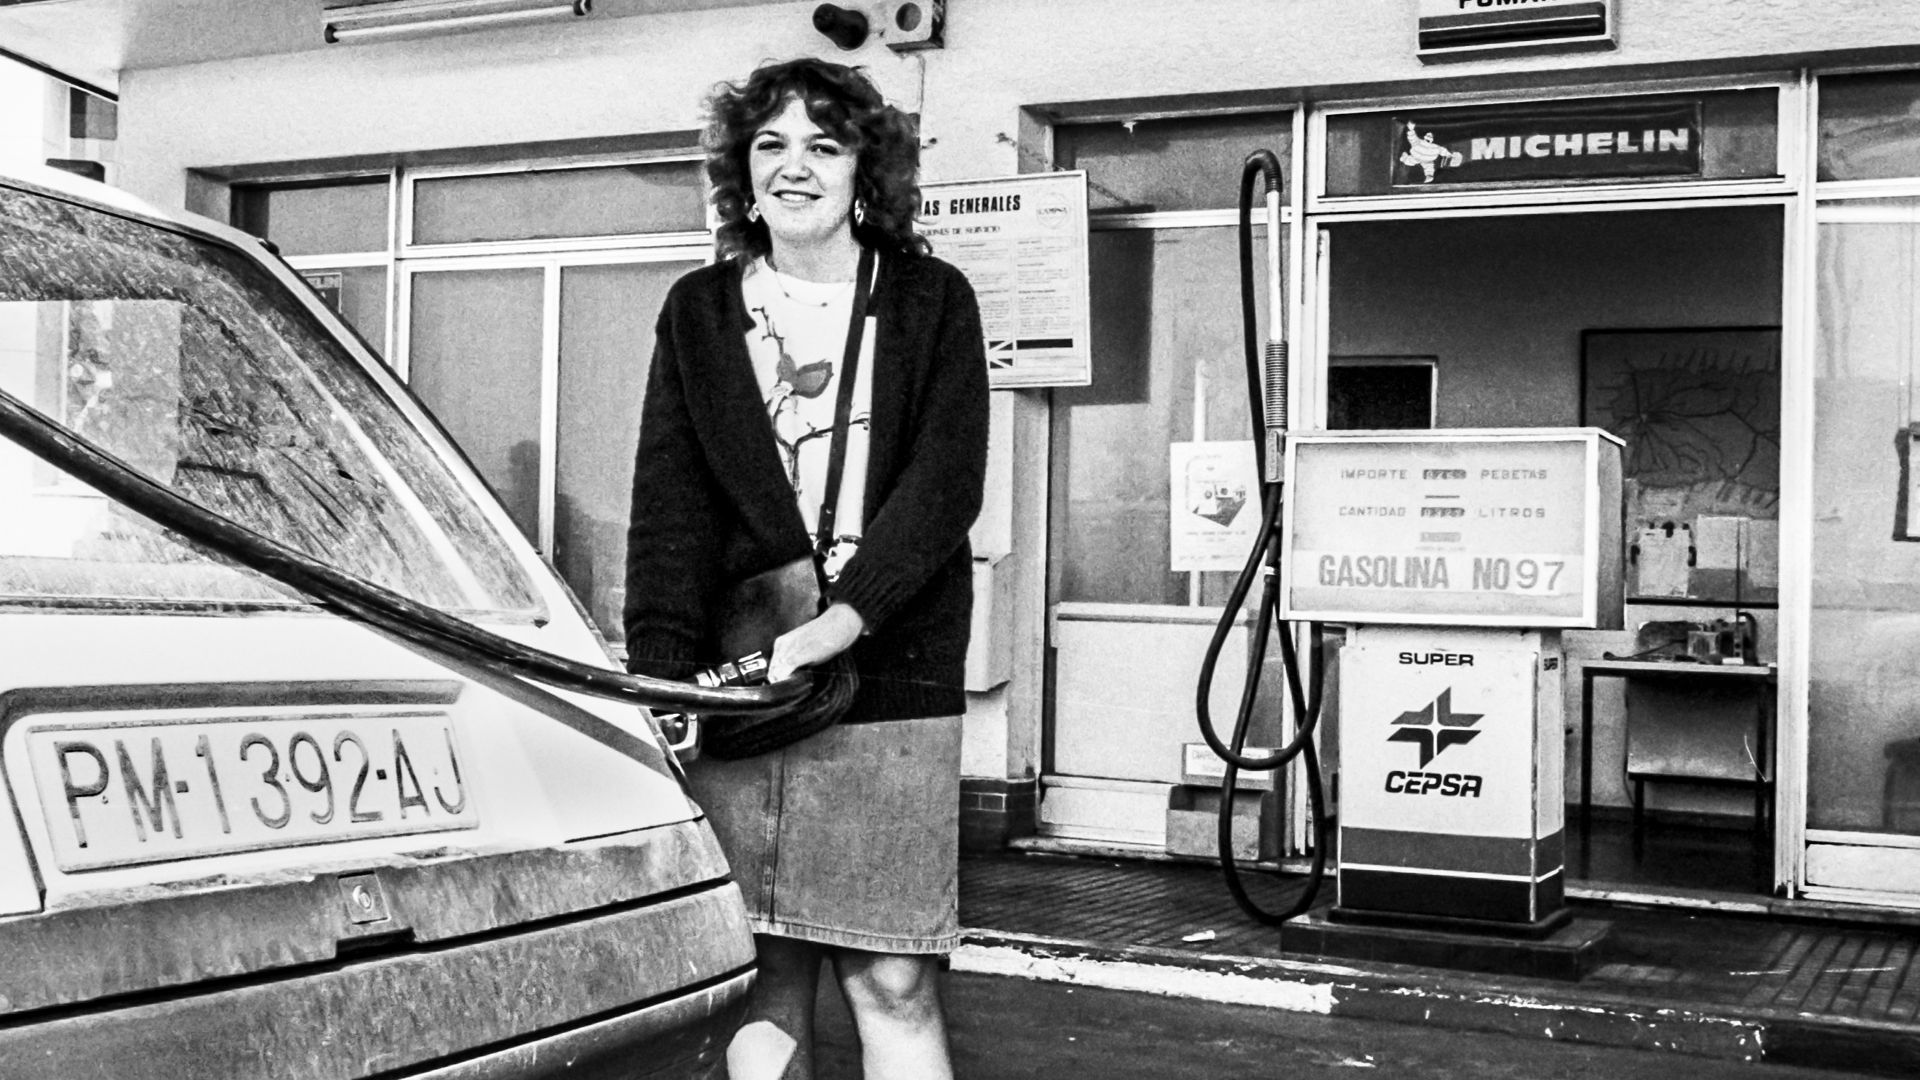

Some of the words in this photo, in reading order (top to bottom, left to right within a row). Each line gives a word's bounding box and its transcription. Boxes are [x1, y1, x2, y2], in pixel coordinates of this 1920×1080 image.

[1470, 128, 1689, 161] MICHELIN
[950, 195, 1020, 215] GENERALES
[1341, 469, 1408, 480] IMPORTE
[1339, 507, 1406, 517] CANTIDAD
[1479, 508, 1546, 518] LITROS
[1318, 555, 1450, 588] GASOLINA
[1399, 652, 1474, 666] SUPER
[1385, 770, 1483, 798] CEPSA
